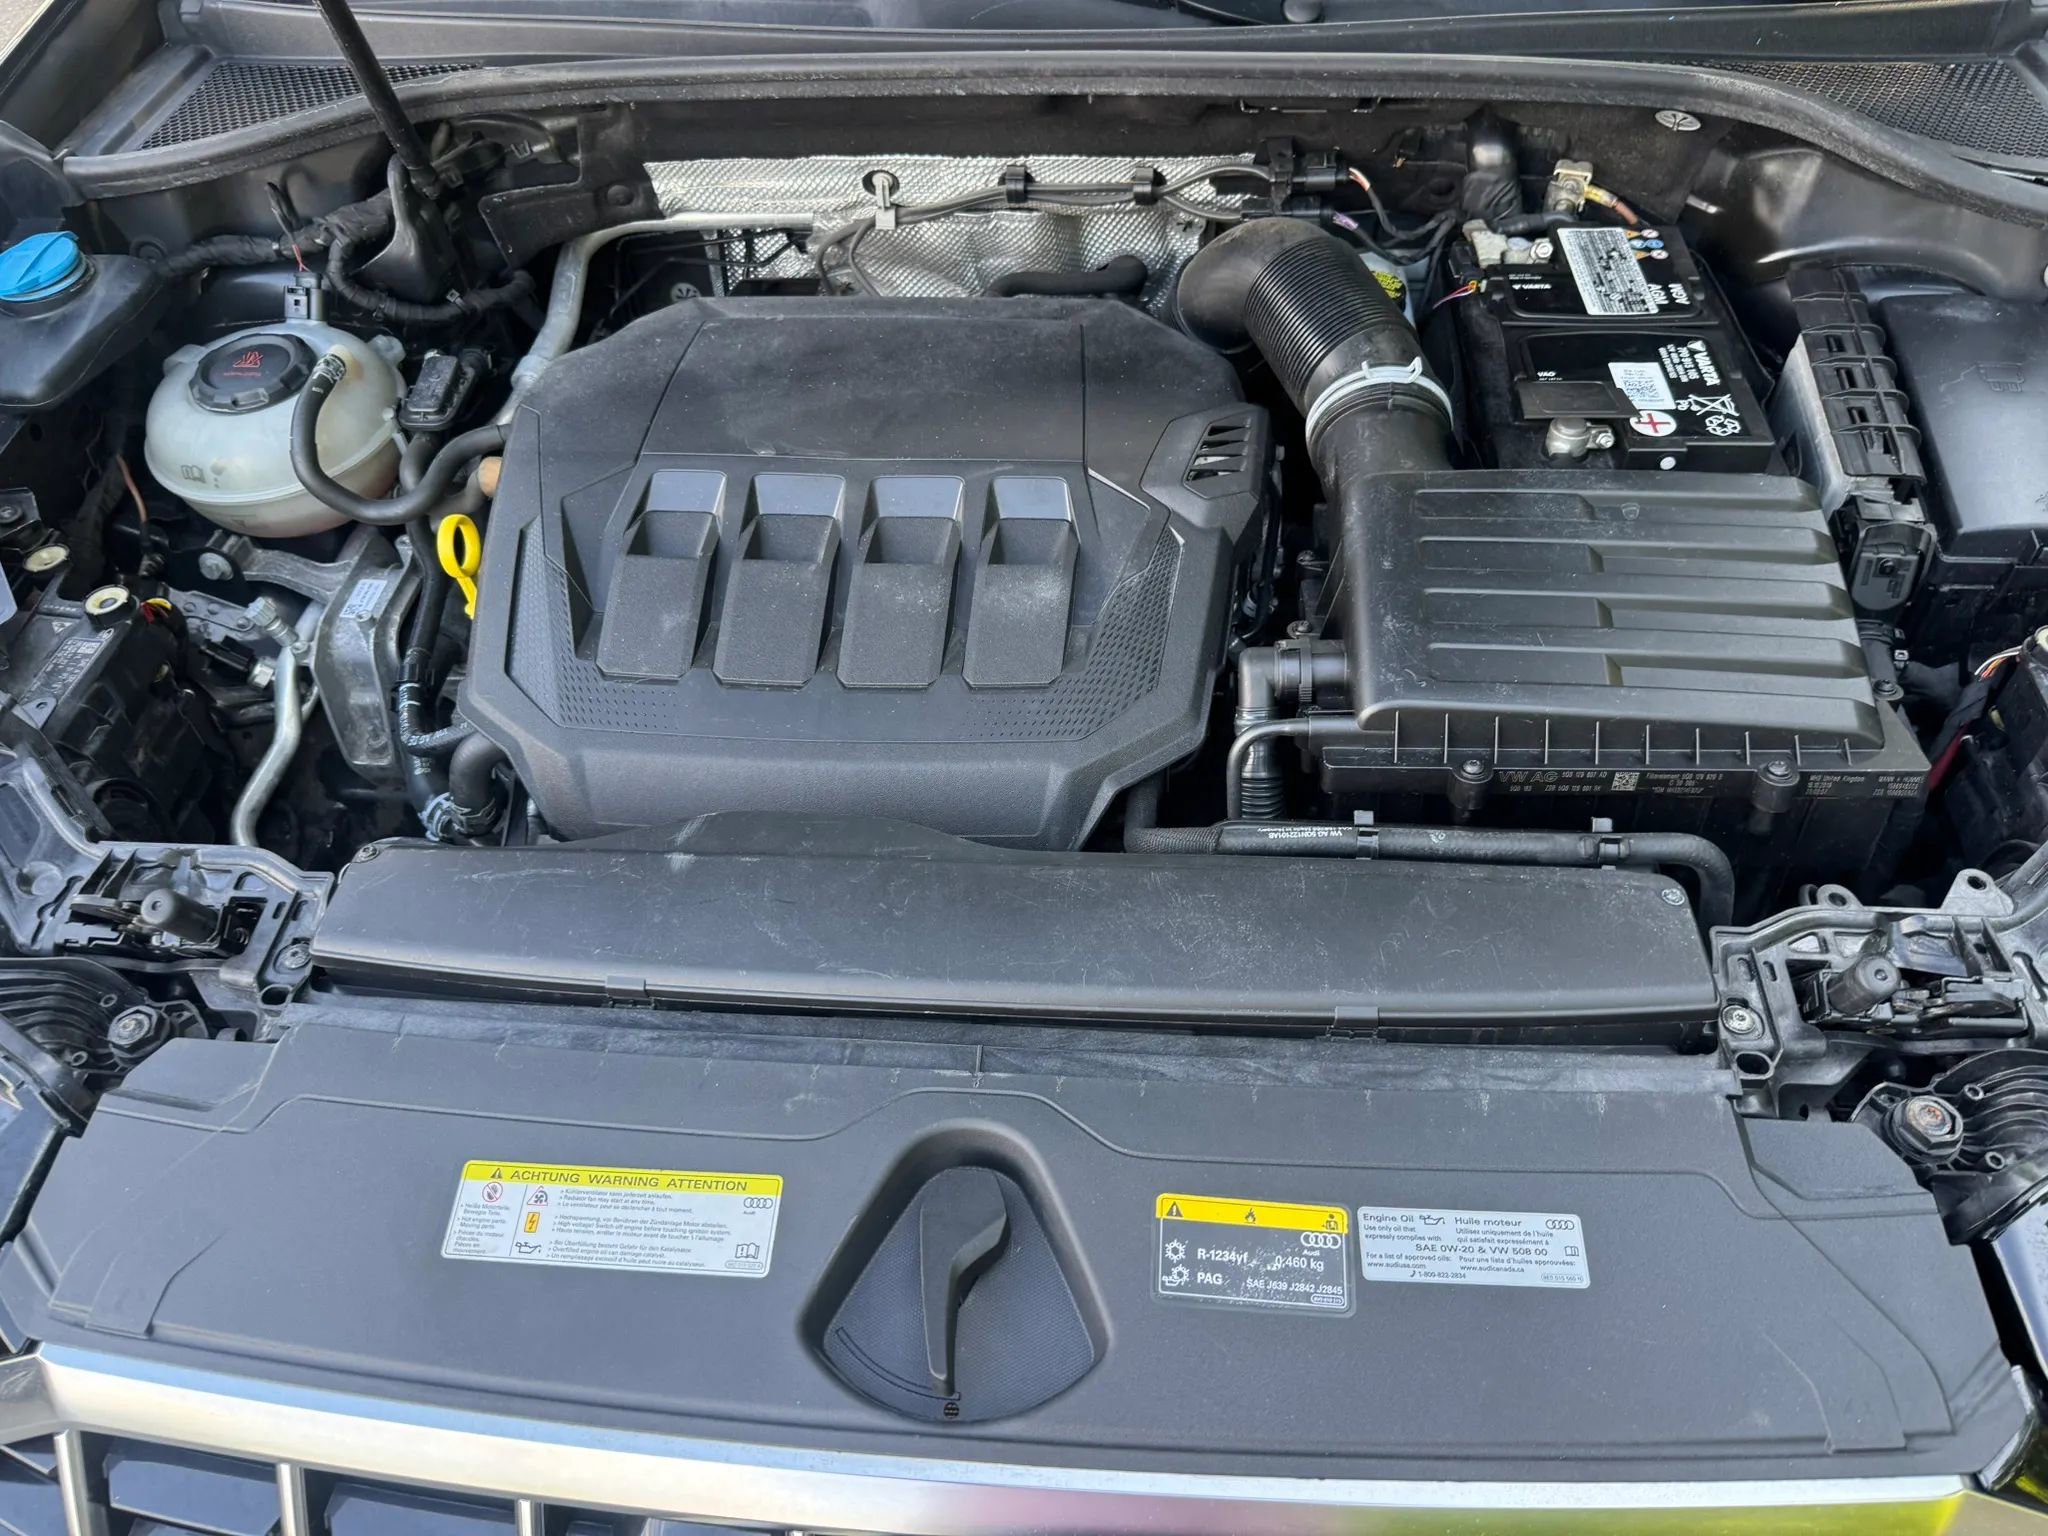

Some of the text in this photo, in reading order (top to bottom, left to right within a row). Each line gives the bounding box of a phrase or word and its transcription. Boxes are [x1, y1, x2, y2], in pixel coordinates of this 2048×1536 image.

[1648, 284, 1668, 305] AGM
[1694, 352, 1720, 386] VARTA
[1499, 772, 1528, 782] VW
[1530, 772, 1559, 782] AG
[1318, 830, 1328, 838] AG
[509, 1169, 748, 1191] ACHTUNG WARNING ATTENTION
[1362, 1212, 1413, 1222] Engine Oil
[1454, 1216, 1522, 1226] Huile moteur
[1480, 1228, 1521, 1236] uniquement
[1415, 1243, 1548, 1256] SAE 0W-20 & VW 508 00
[1197, 1247, 1248, 1264] R-1234yf
[1310, 1257, 1324, 1271] kg
[1384, 1252, 1394, 1260] list
[1404, 1253, 1436, 1261] approved
[1367, 1260, 1426, 1268] www.audiusa.com
[1459, 1264, 1524, 1272] www.audicanada.ca
[1197, 1271, 1222, 1285] PAG
[1418, 1270, 1465, 1279] 1-800-822-2834
[1246, 1278, 1343, 1295] SAE J639 J2842 J2845
